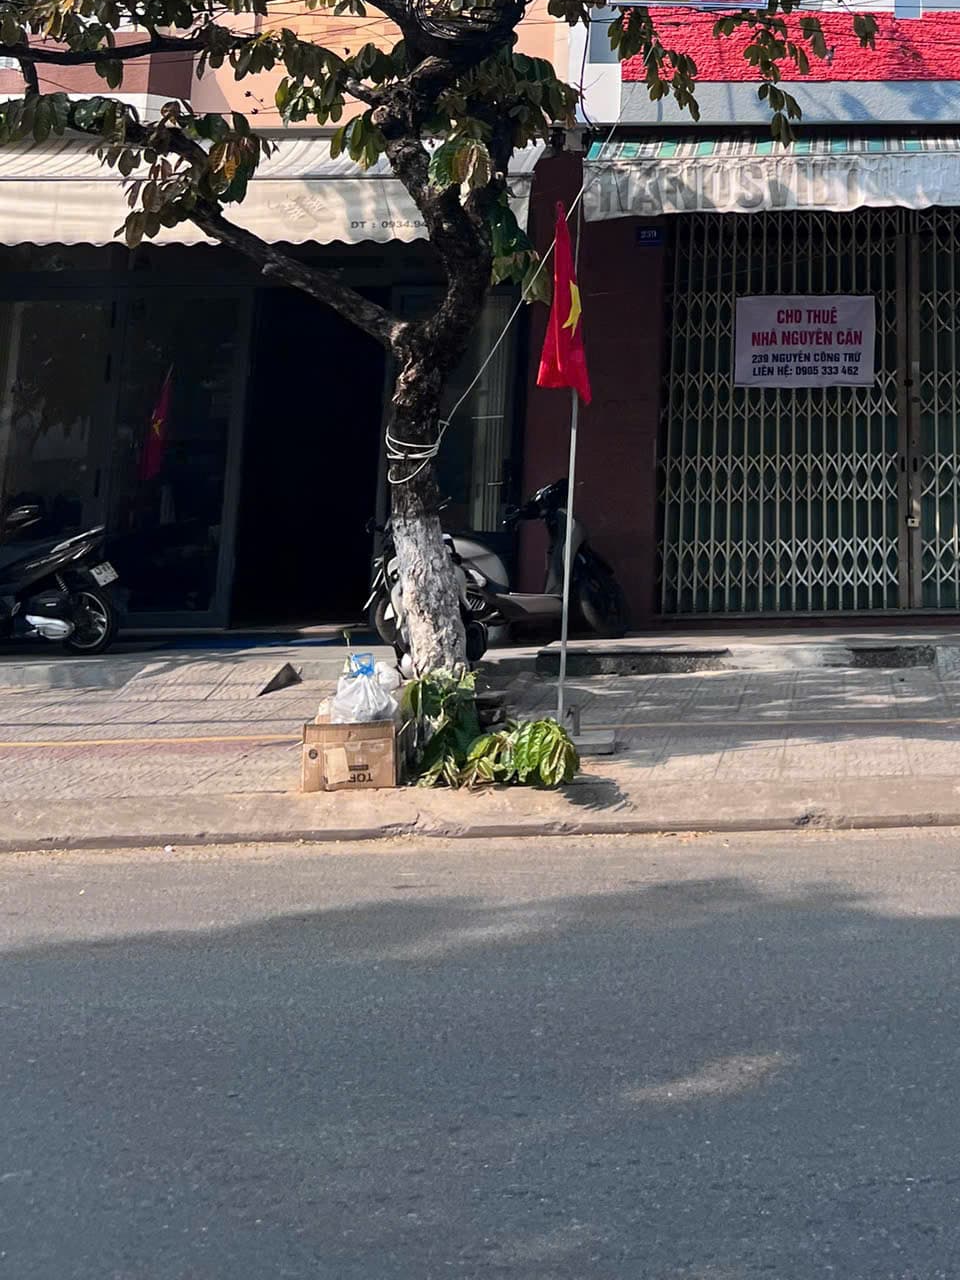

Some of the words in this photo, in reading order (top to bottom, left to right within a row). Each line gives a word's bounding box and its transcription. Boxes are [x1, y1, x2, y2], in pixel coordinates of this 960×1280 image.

[777, 309, 802, 324] CHO
[806, 306, 837, 324] THUÊ
[782, 327, 832, 346] NGUYÊN
[814, 351, 840, 363] CÔNG
[752, 365, 774, 376] LIÊN
[821, 366, 839, 376] 333
